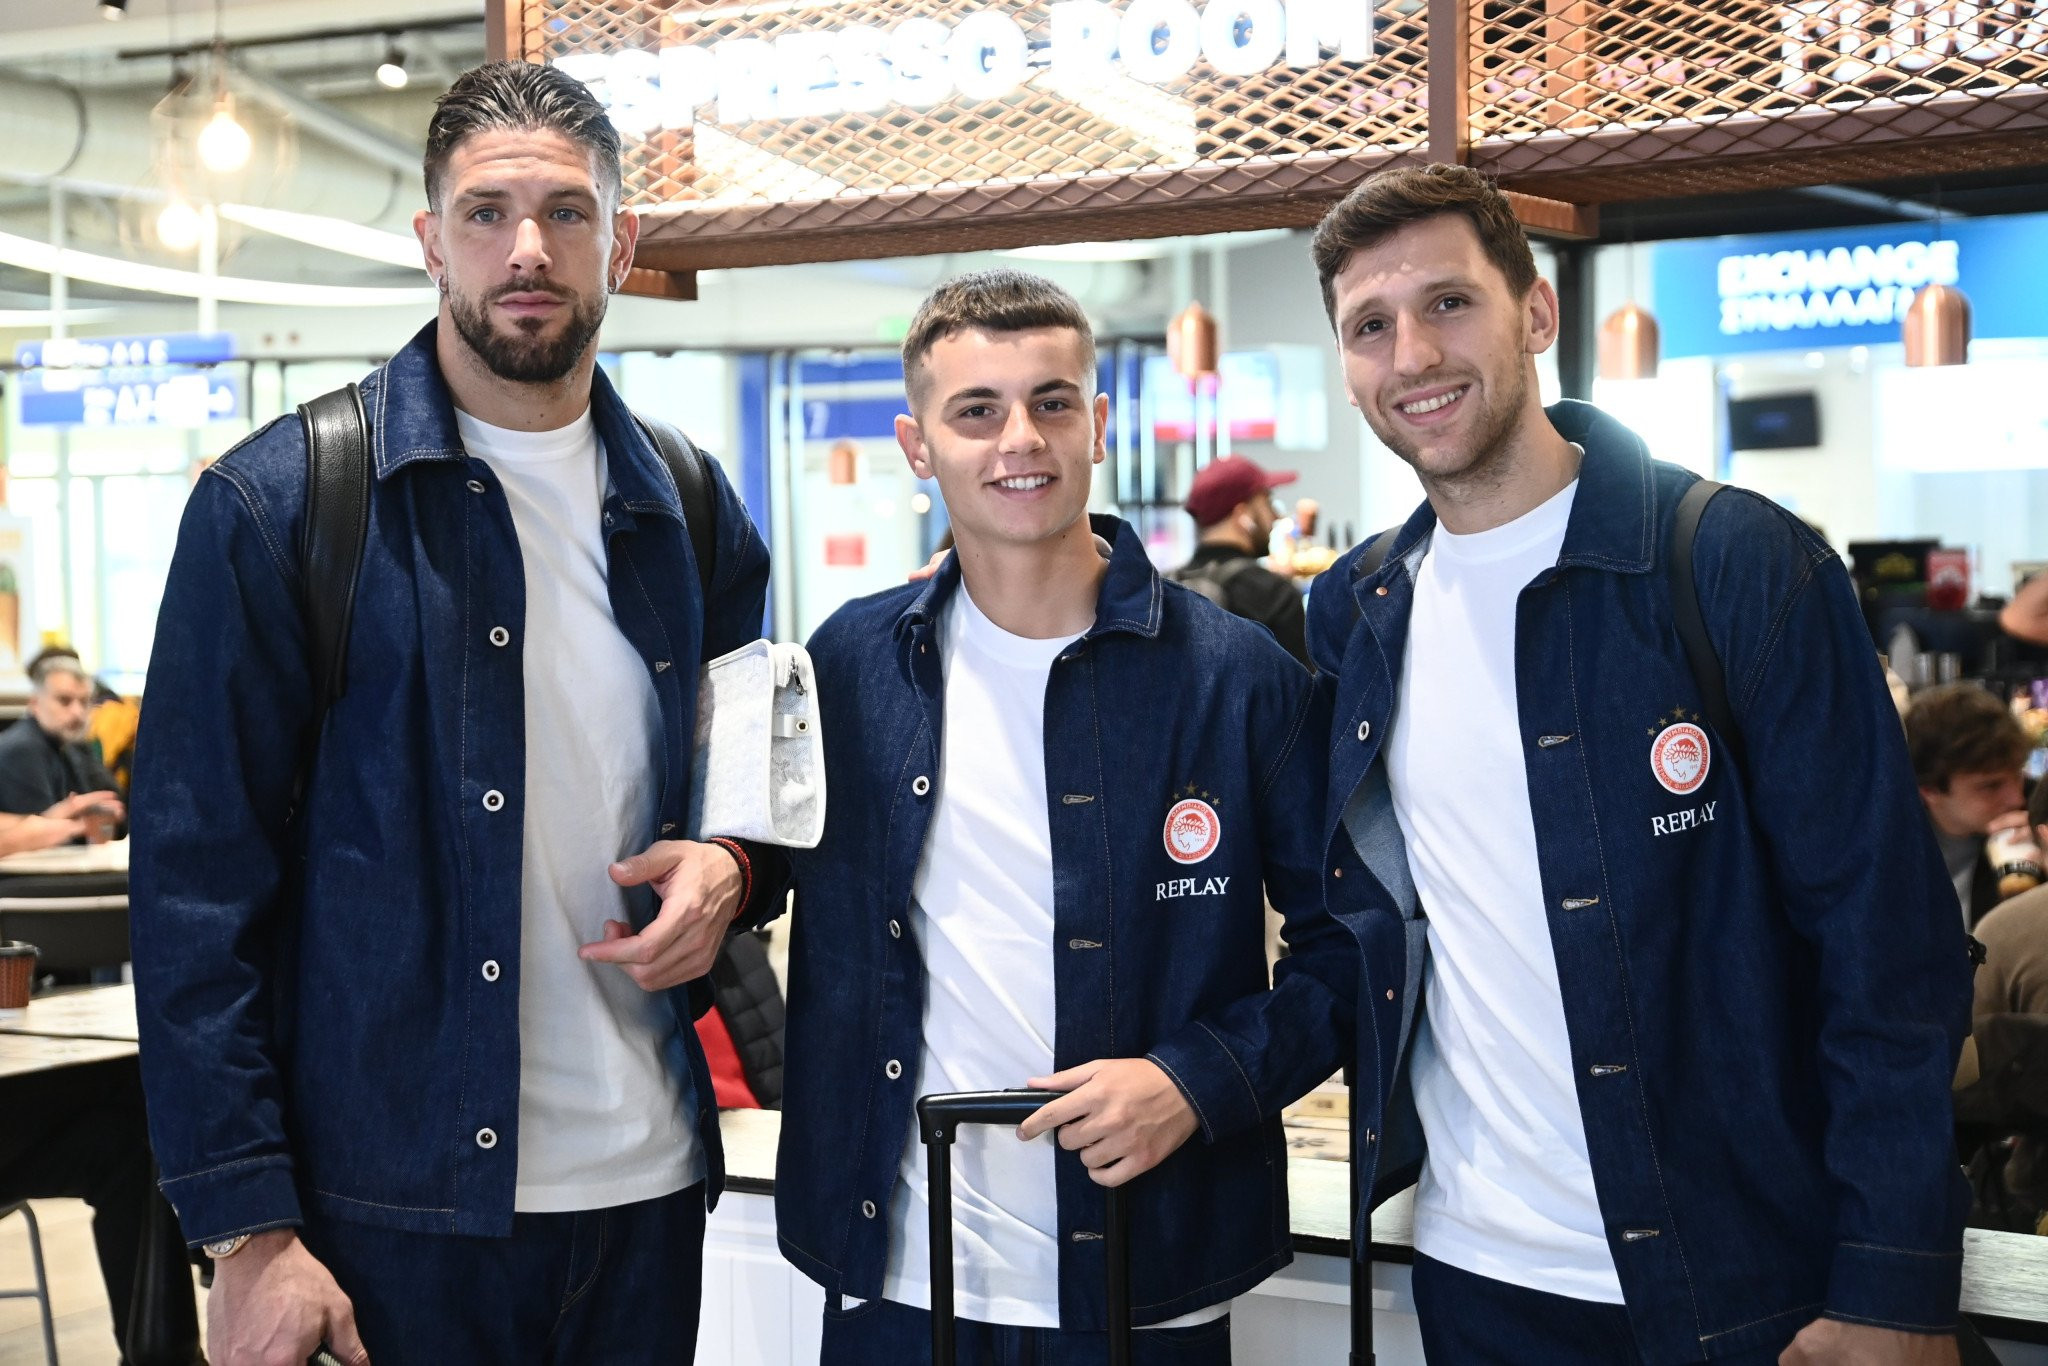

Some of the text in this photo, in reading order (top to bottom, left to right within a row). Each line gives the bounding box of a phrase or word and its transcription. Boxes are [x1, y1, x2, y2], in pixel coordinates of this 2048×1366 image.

[1050, 0, 1375, 86] ROOM
[1718, 240, 1959, 299] EXCHANGE
[1651, 801, 1717, 837] REPLAY
[1156, 877, 1230, 901] REPLAY
